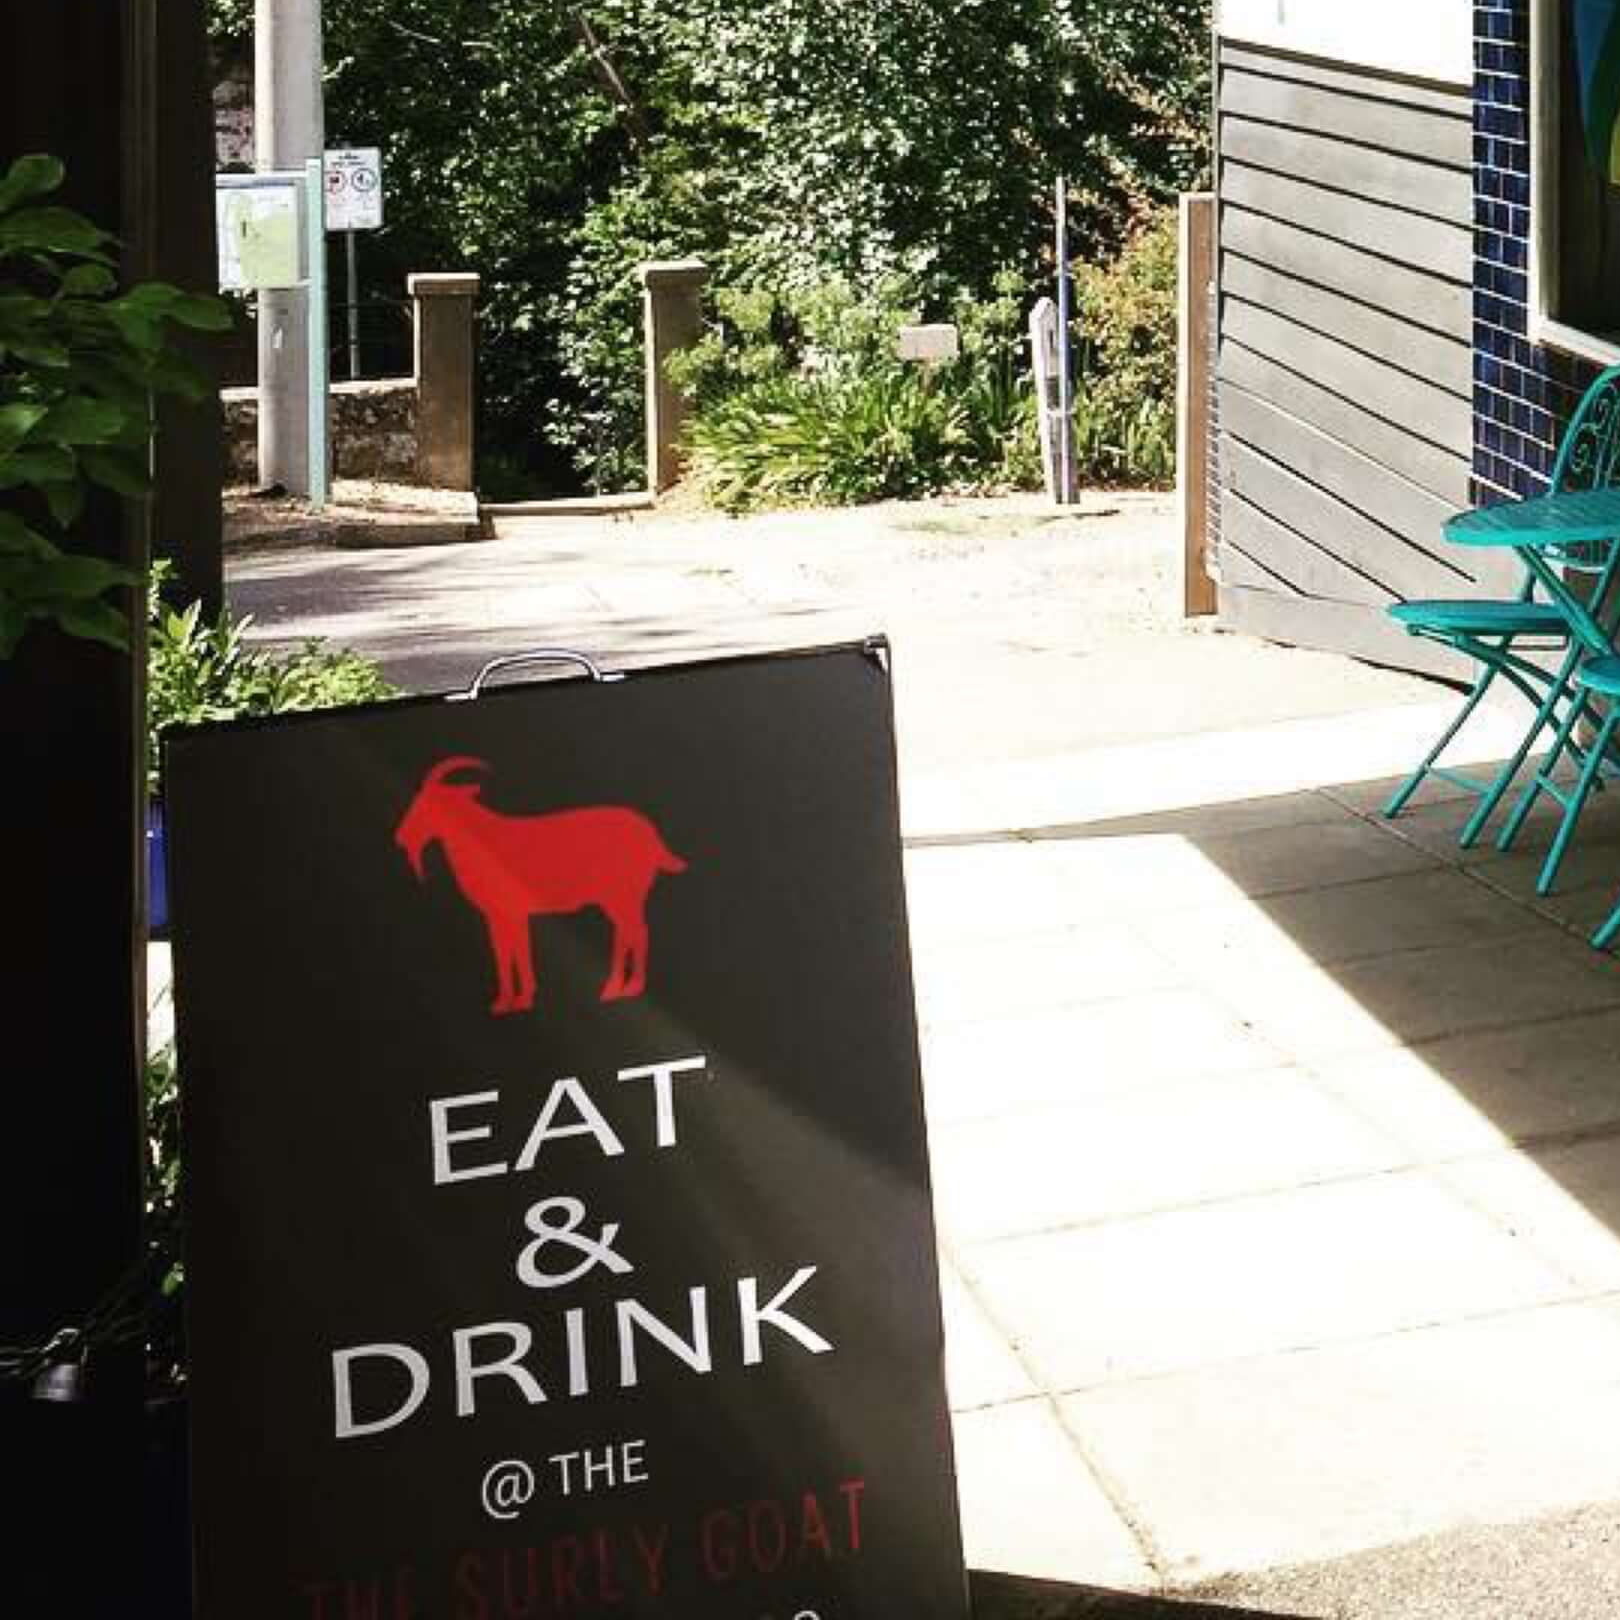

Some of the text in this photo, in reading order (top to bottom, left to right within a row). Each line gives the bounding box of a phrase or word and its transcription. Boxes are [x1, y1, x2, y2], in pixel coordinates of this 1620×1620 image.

[430, 1055, 707, 1185] EAT
[516, 1196, 636, 1288] &
[331, 1264, 836, 1440] DRINK
[480, 1439, 650, 1521] @ THE
[454, 1522, 669, 1620] SURLY
[701, 1478, 866, 1581] GOAT
